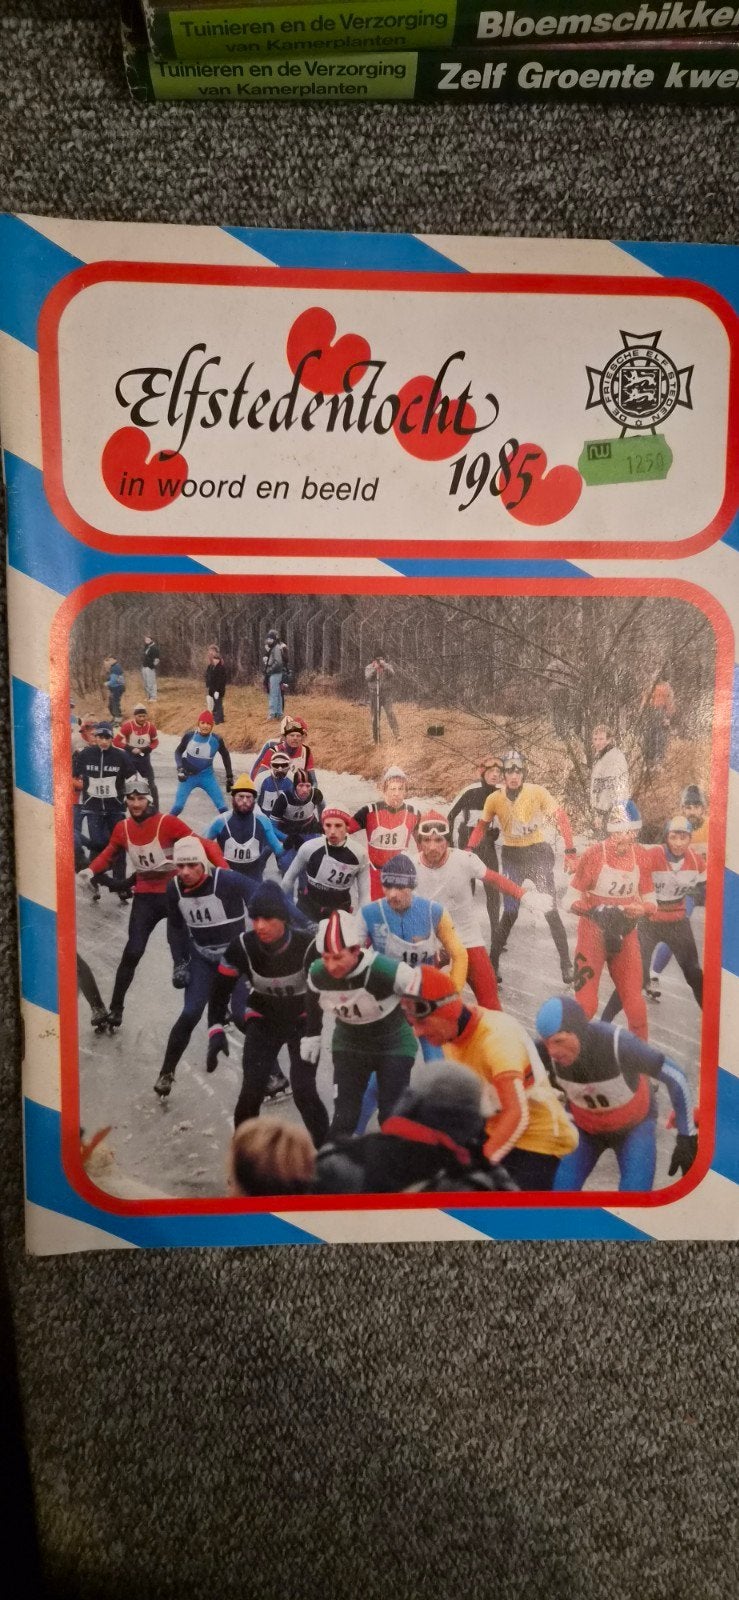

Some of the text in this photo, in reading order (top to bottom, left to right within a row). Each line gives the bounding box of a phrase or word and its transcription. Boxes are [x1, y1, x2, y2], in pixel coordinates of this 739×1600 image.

[180, 10, 448, 38] Tuinieren en de Verzorging
[225, 34, 406, 52] van Kamerplanten
[157, 61, 406, 79] Tuinieren en de Verzorging
[438, 61, 739, 90] Zelf Groente kwe
[198, 82, 368, 98] van Kamerplanten
[602, 349, 676, 422] DE FRIESCHE ELF STEDEN
[449, 438, 541, 511] 1985
[119, 472, 380, 502] in woord en beeld
[379, 833, 398, 845] 136
[327, 869, 352, 885] 236
[189, 908, 212, 923] 144
